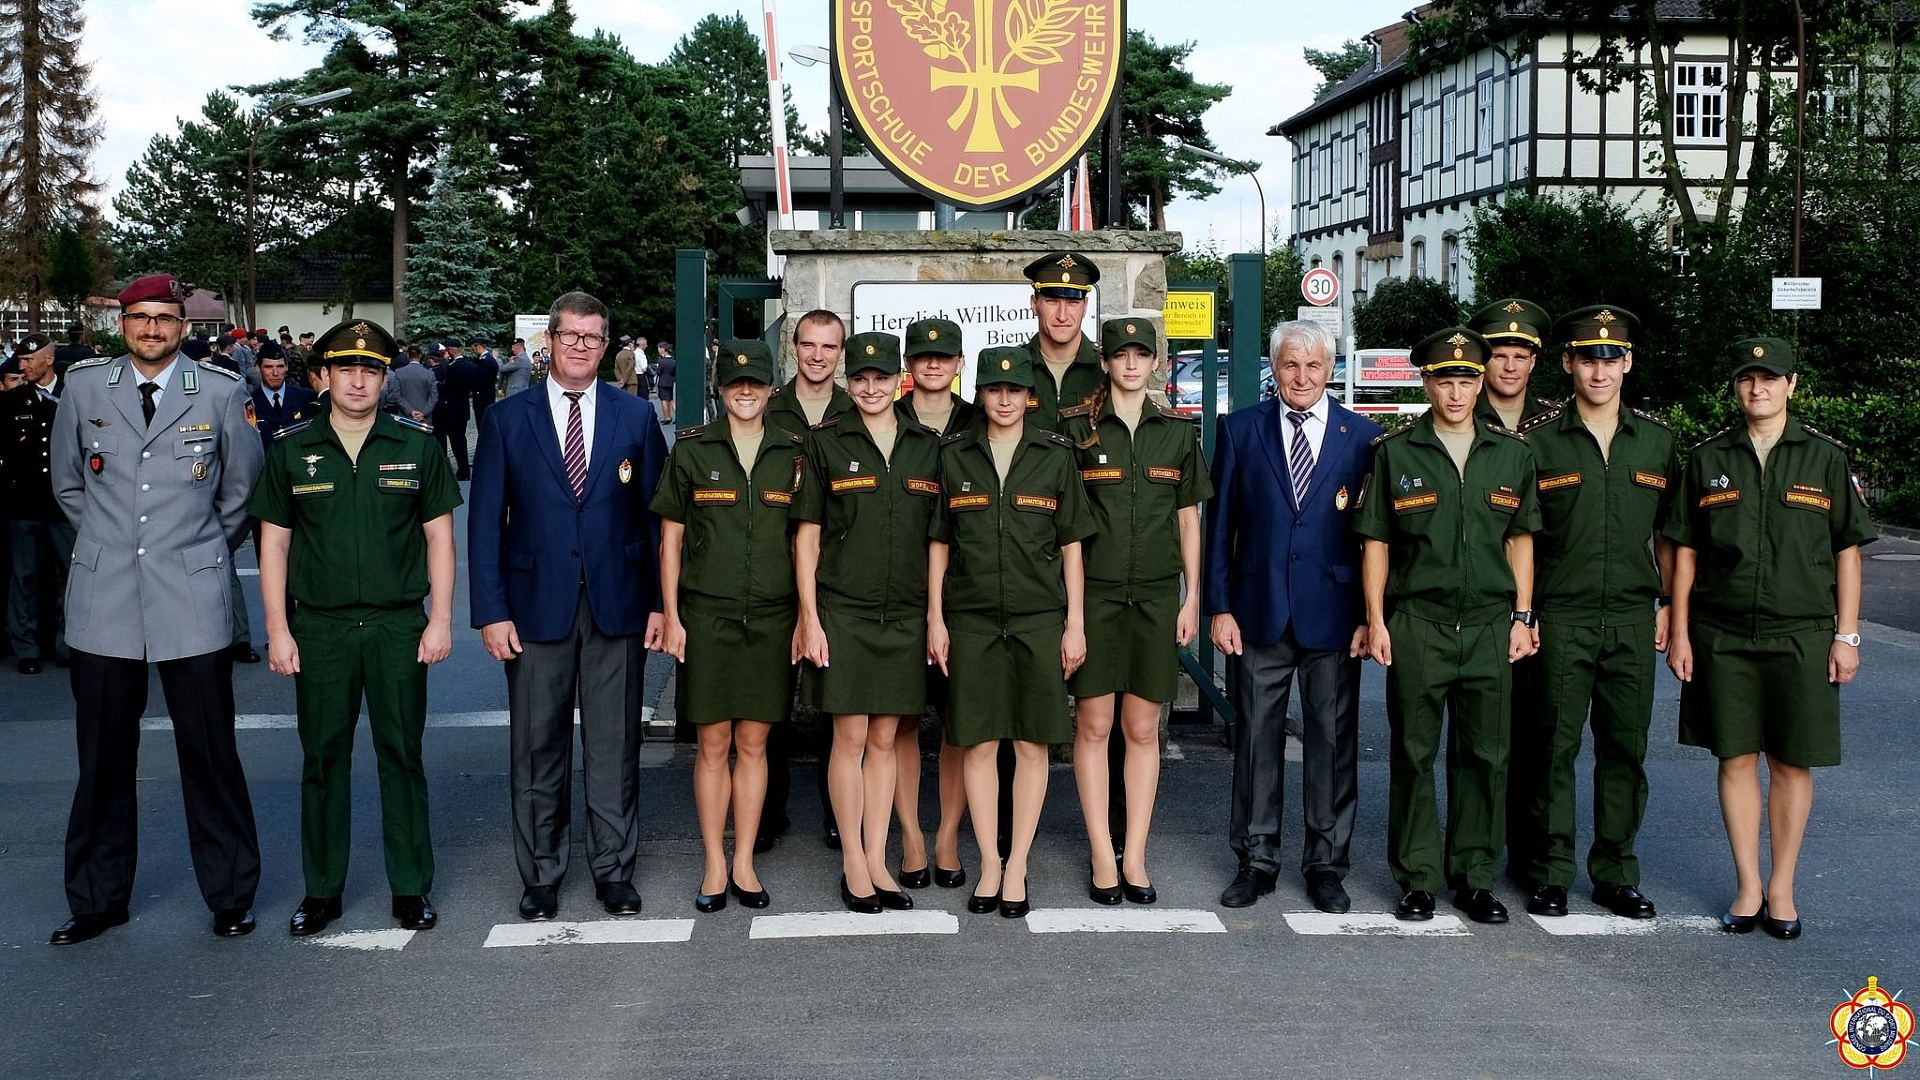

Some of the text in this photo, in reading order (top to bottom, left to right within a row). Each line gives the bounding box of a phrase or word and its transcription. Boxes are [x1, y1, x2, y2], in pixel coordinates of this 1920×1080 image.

[851, 1, 1106, 188] SPORTSCHULE DER BUNDESWEHR
[1310, 279, 1331, 295] 30
[1165, 298, 1206, 310] inweis
[956, 305, 1037, 324] Willkom
[986, 328, 1034, 345] Bienv
[1361, 369, 1413, 380] undeswehr
